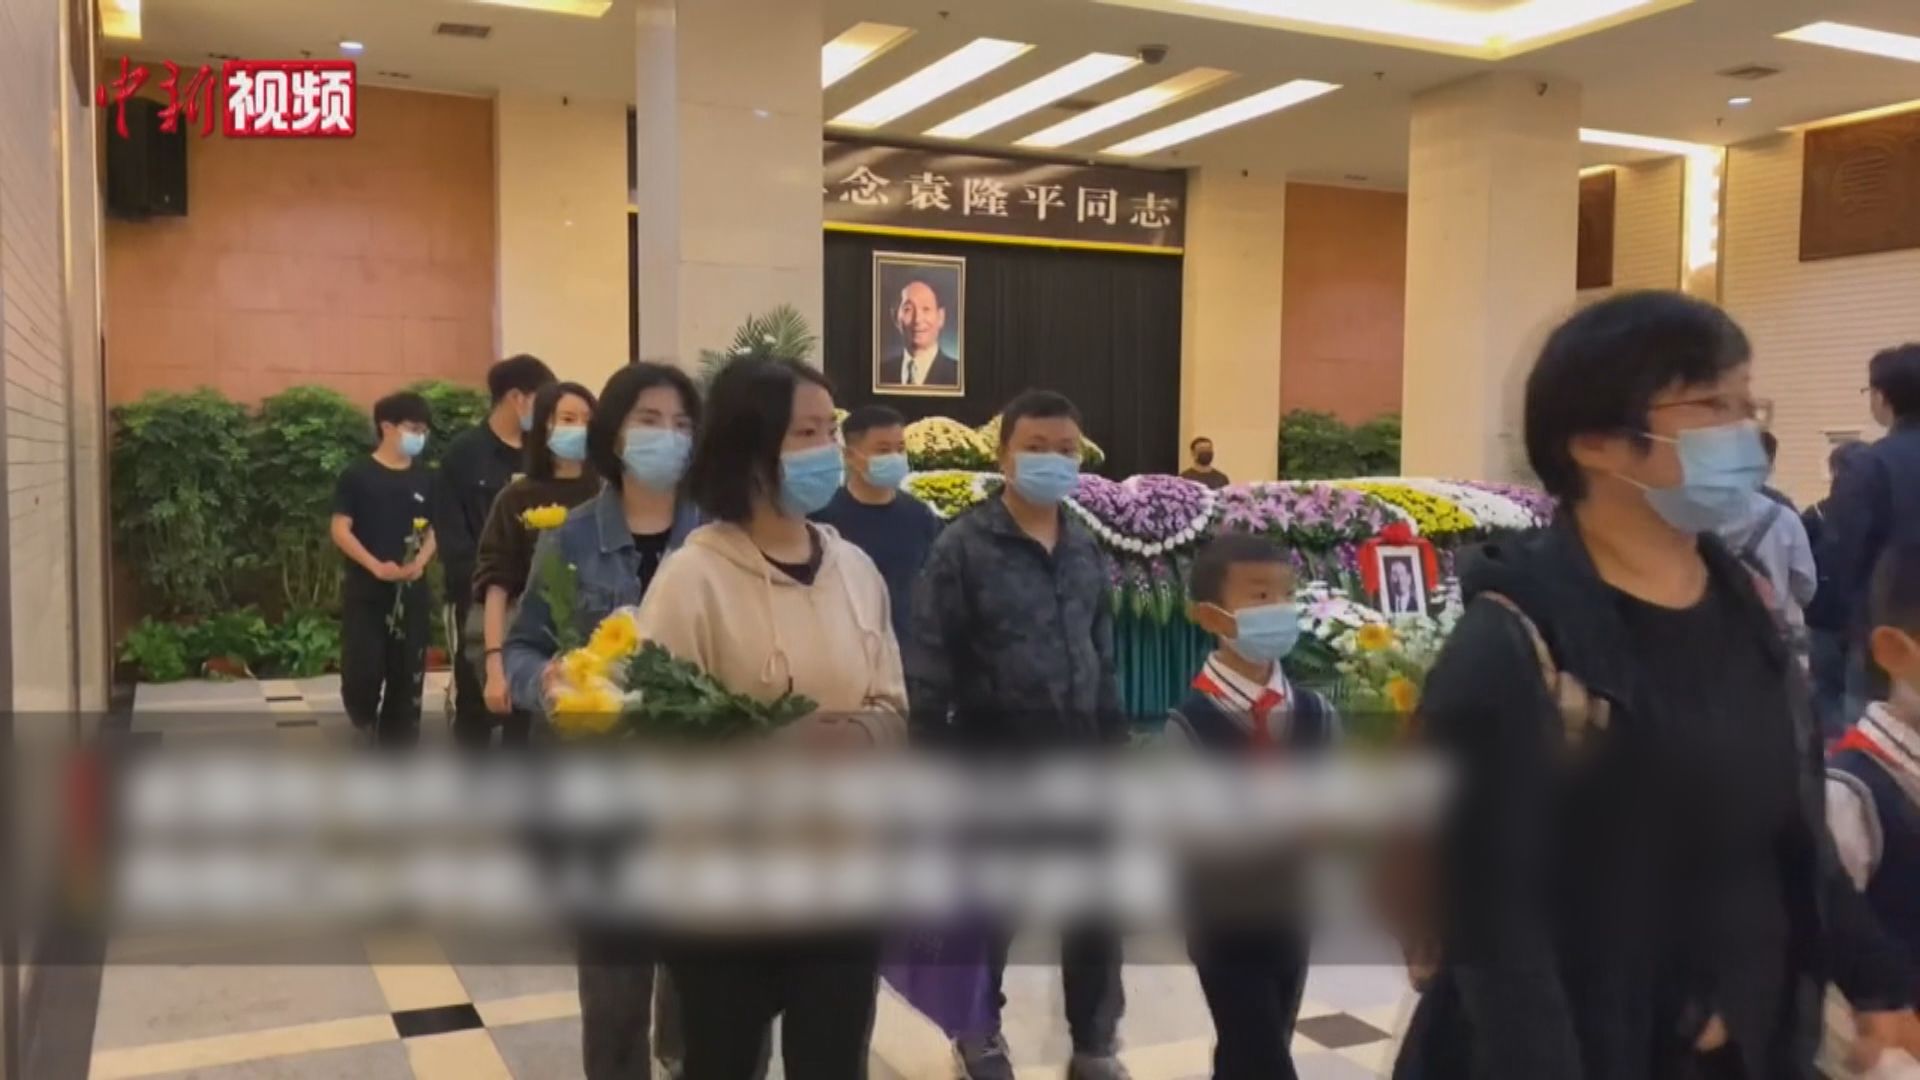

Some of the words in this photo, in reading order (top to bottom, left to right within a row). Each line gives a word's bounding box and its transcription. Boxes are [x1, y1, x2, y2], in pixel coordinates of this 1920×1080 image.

[823, 165, 1174, 228] 念袁隆平同志
